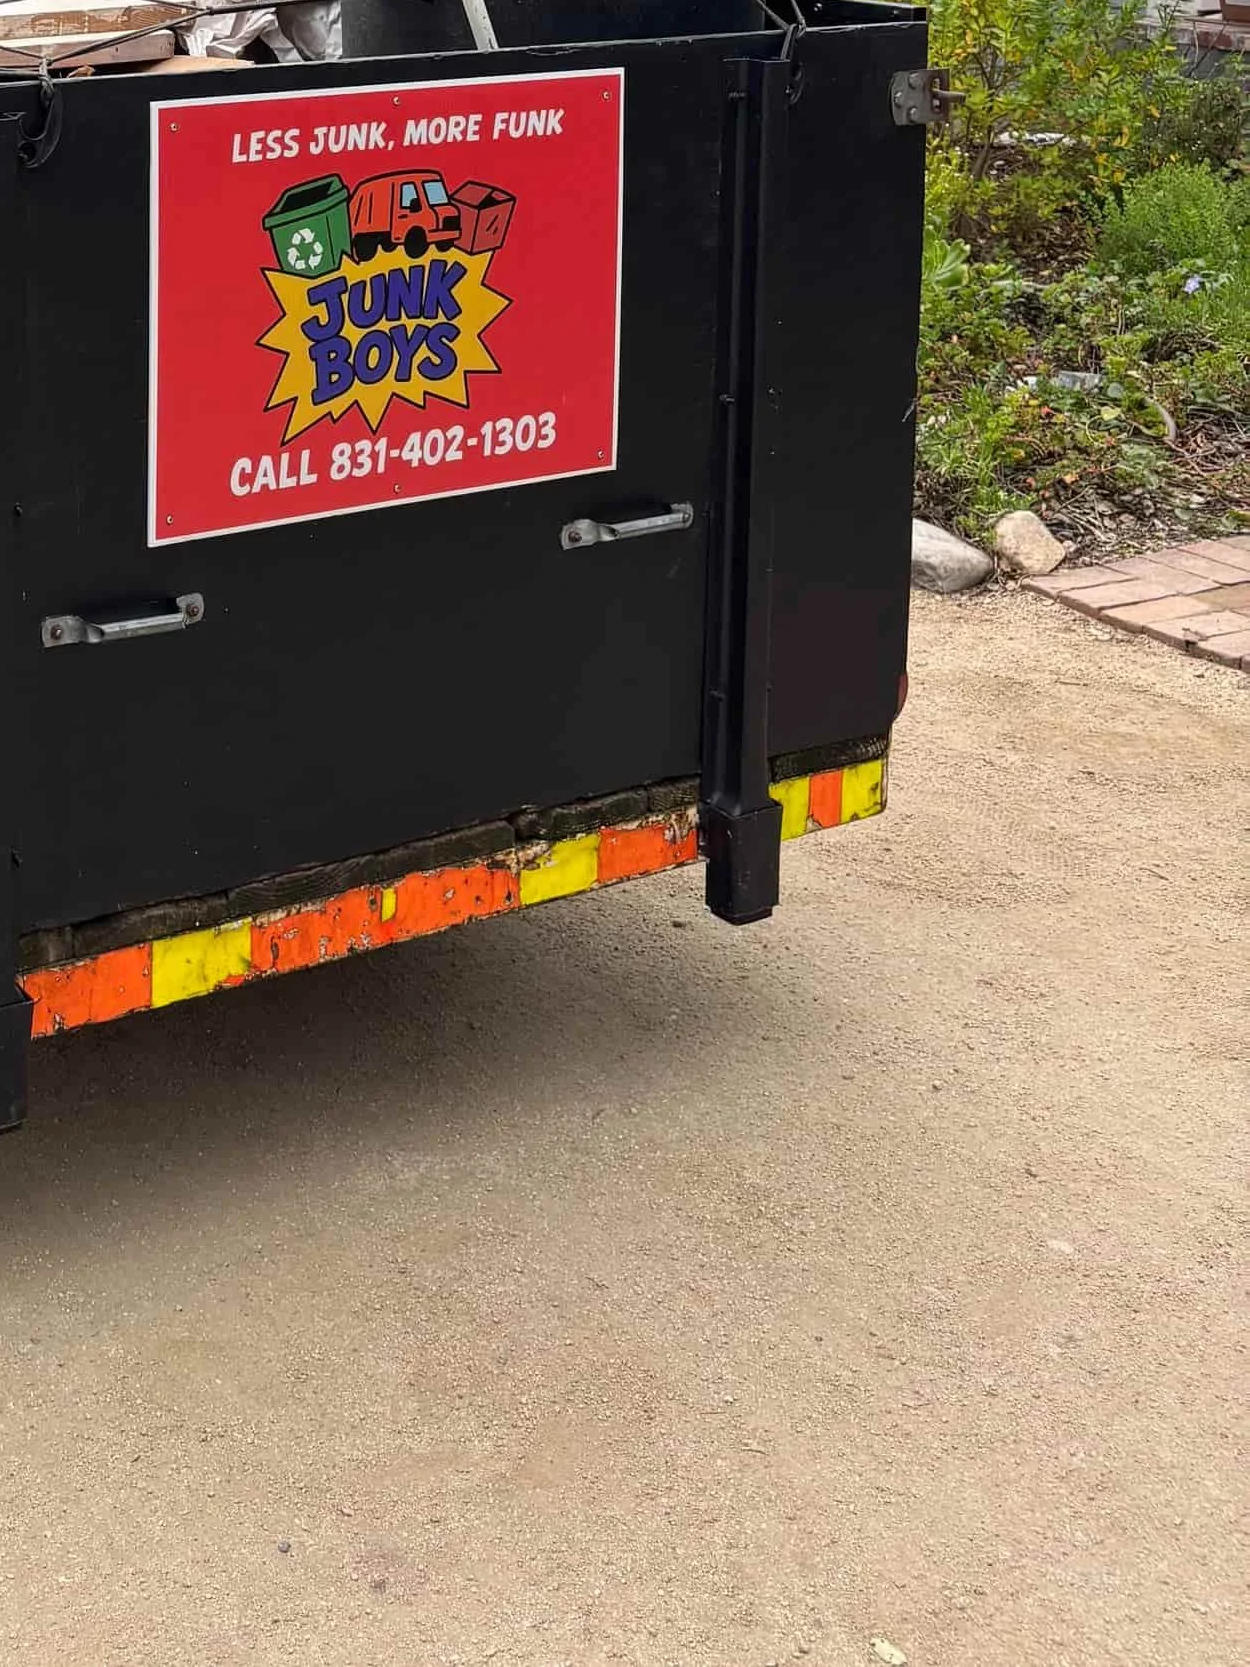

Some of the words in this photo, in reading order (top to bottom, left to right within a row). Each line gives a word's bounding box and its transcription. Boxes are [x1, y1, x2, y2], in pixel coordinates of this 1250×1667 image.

[231, 129, 300, 164] LESS
[309, 122, 395, 156] JUNK,
[403, 115, 483, 147] MORE
[492, 108, 566, 141] FUNK
[300, 259, 469, 343] JUNK
[308, 321, 461, 406] BOYS
[230, 450, 318, 498] CALL
[329, 411, 558, 479] 831-402-1303
